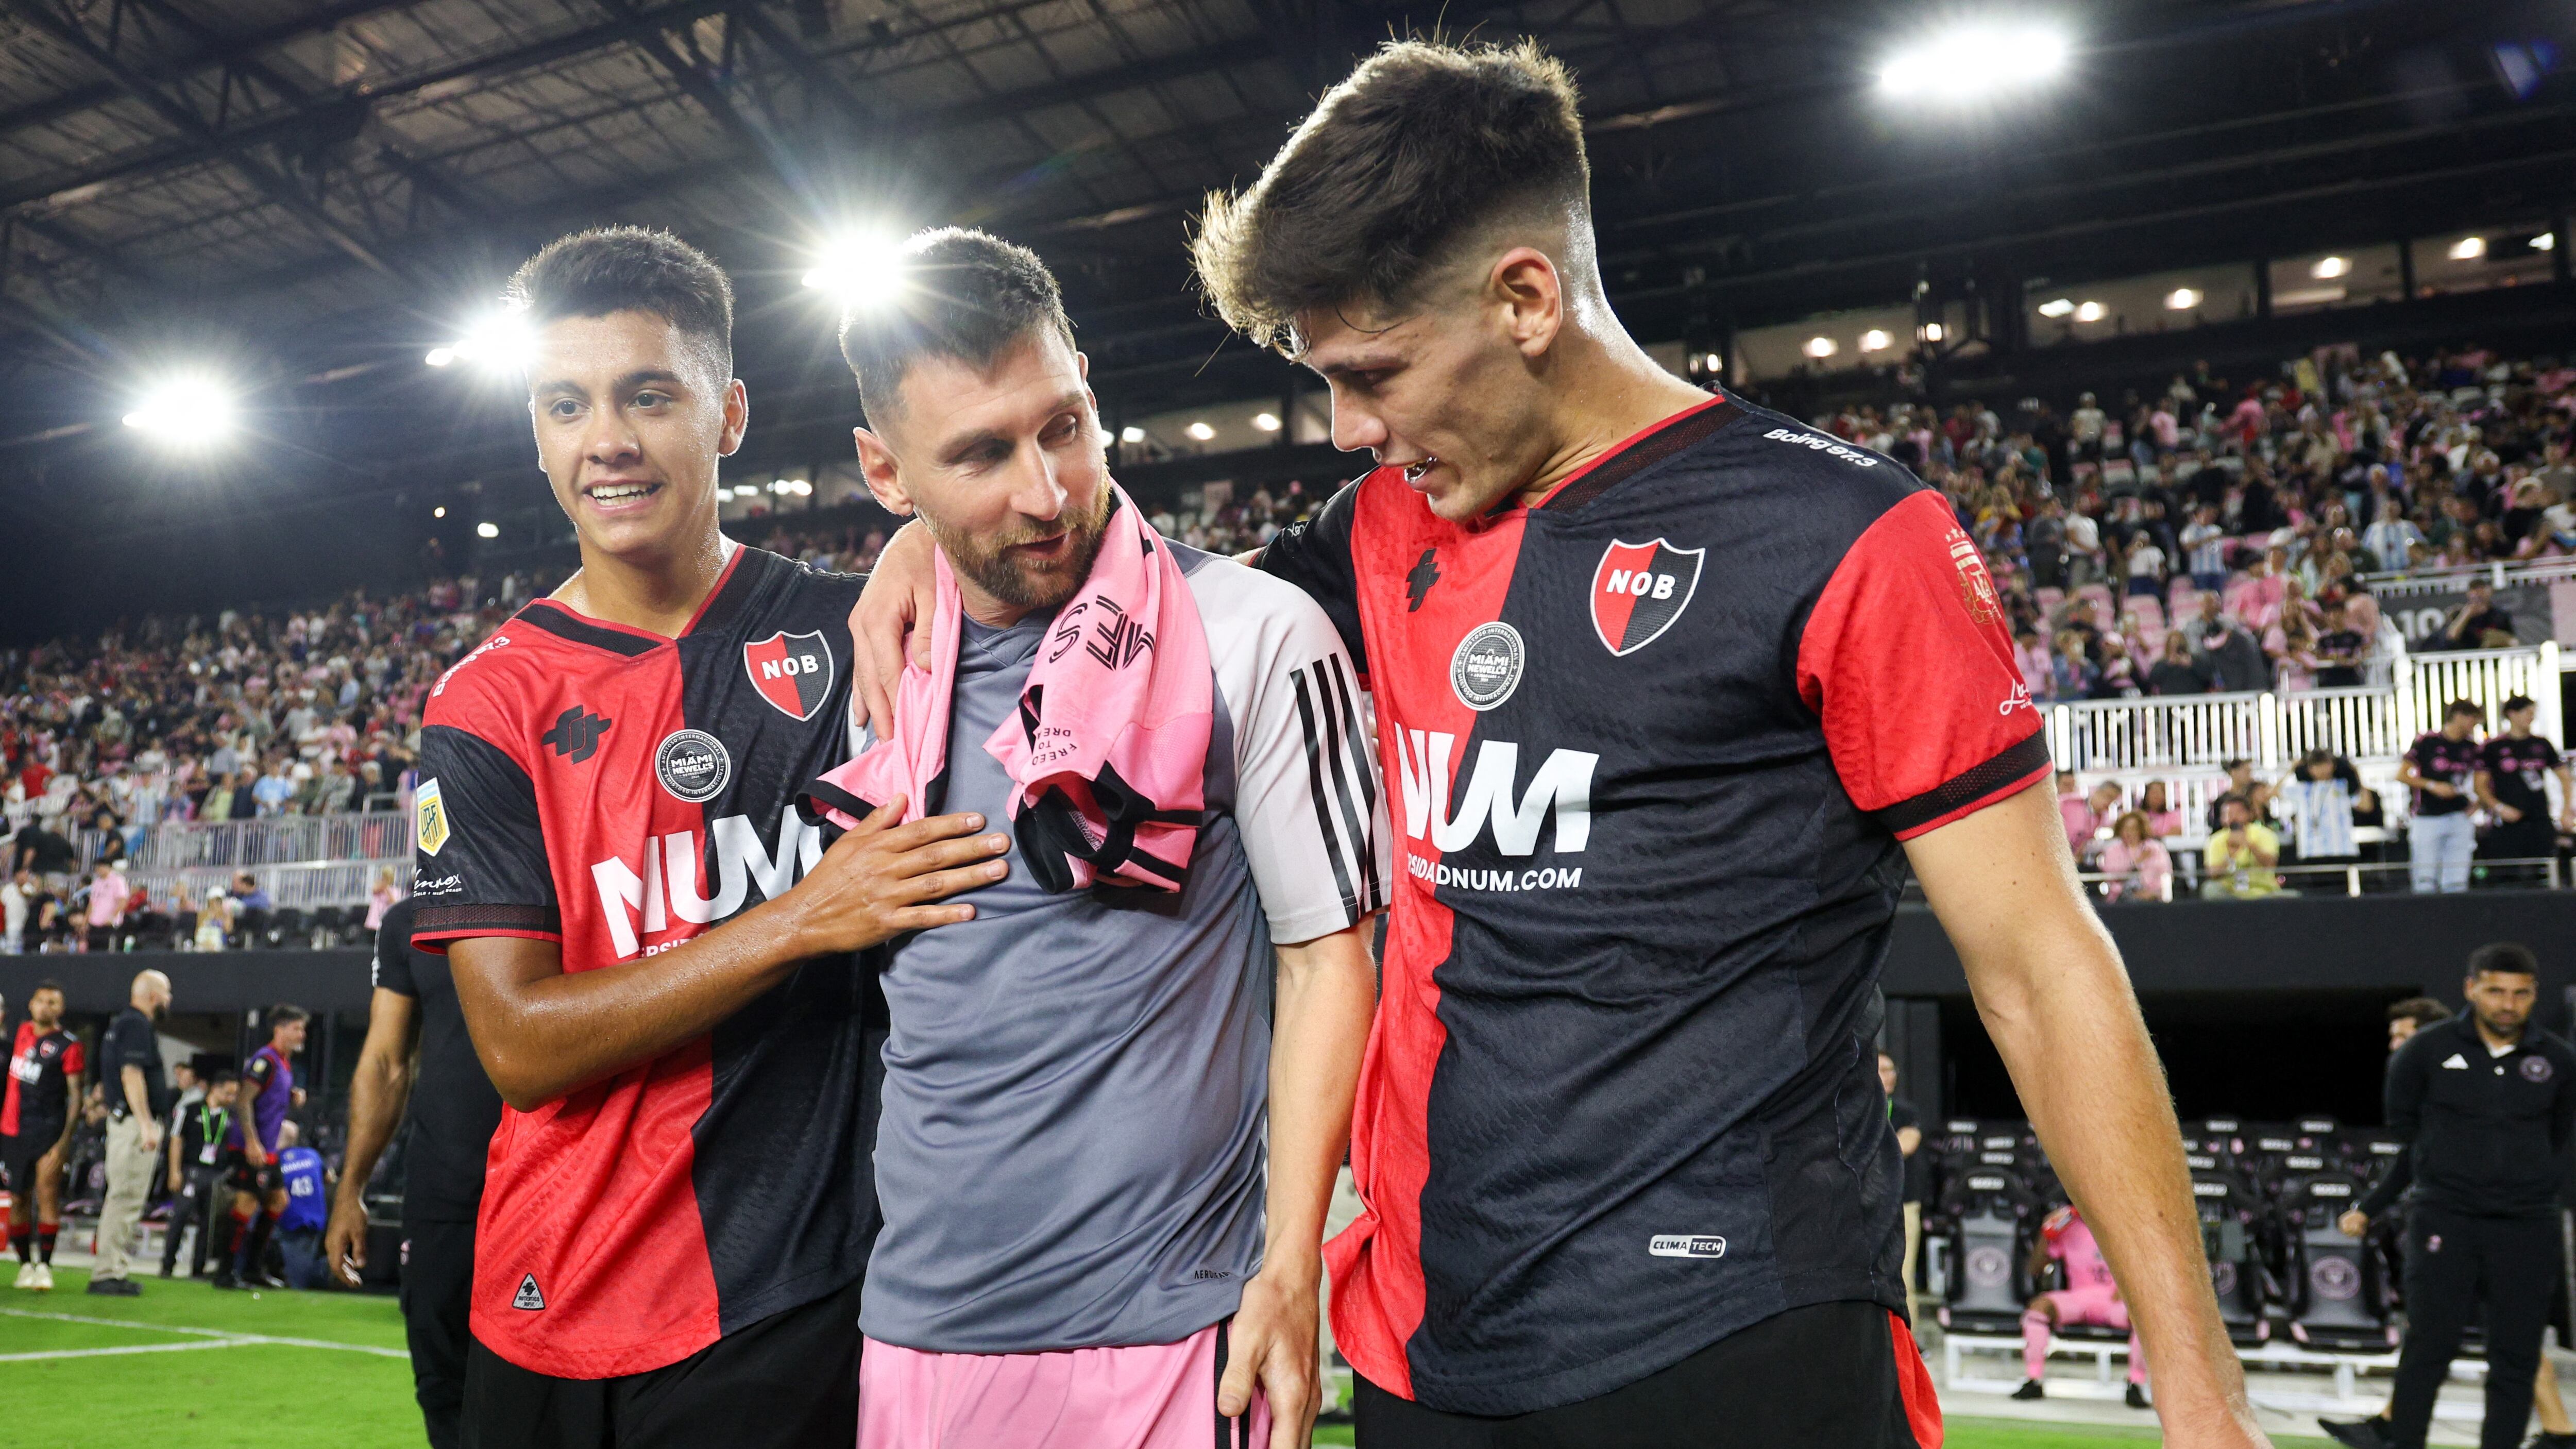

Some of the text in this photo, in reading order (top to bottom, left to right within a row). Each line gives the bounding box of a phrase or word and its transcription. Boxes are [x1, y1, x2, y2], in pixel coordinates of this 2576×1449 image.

[1763, 429, 1878, 467] Boing 97.3
[1606, 569, 1676, 600] NOB
[1461, 628, 1519, 661] AMISTOSO INTERNACIONAL
[761, 655, 819, 680] NOB
[1467, 664, 1507, 675] NEWELL'S
[1469, 654, 1510, 666] MIAMI
[1457, 669, 1515, 702] AMISTOSO INTERNACIONAL
[661, 734, 721, 764] AMISTOSO INTERNACIONAL
[1039, 740, 1051, 749] TO
[670, 754, 713, 768] MIAMI
[672, 762, 715, 774] NEWELL'S
[664, 765, 725, 795] AMISTOSO INTERNACIONAL
[1395, 721, 1600, 856] NUM
[1653, 1241, 1721, 1251] CLIMA TECH
